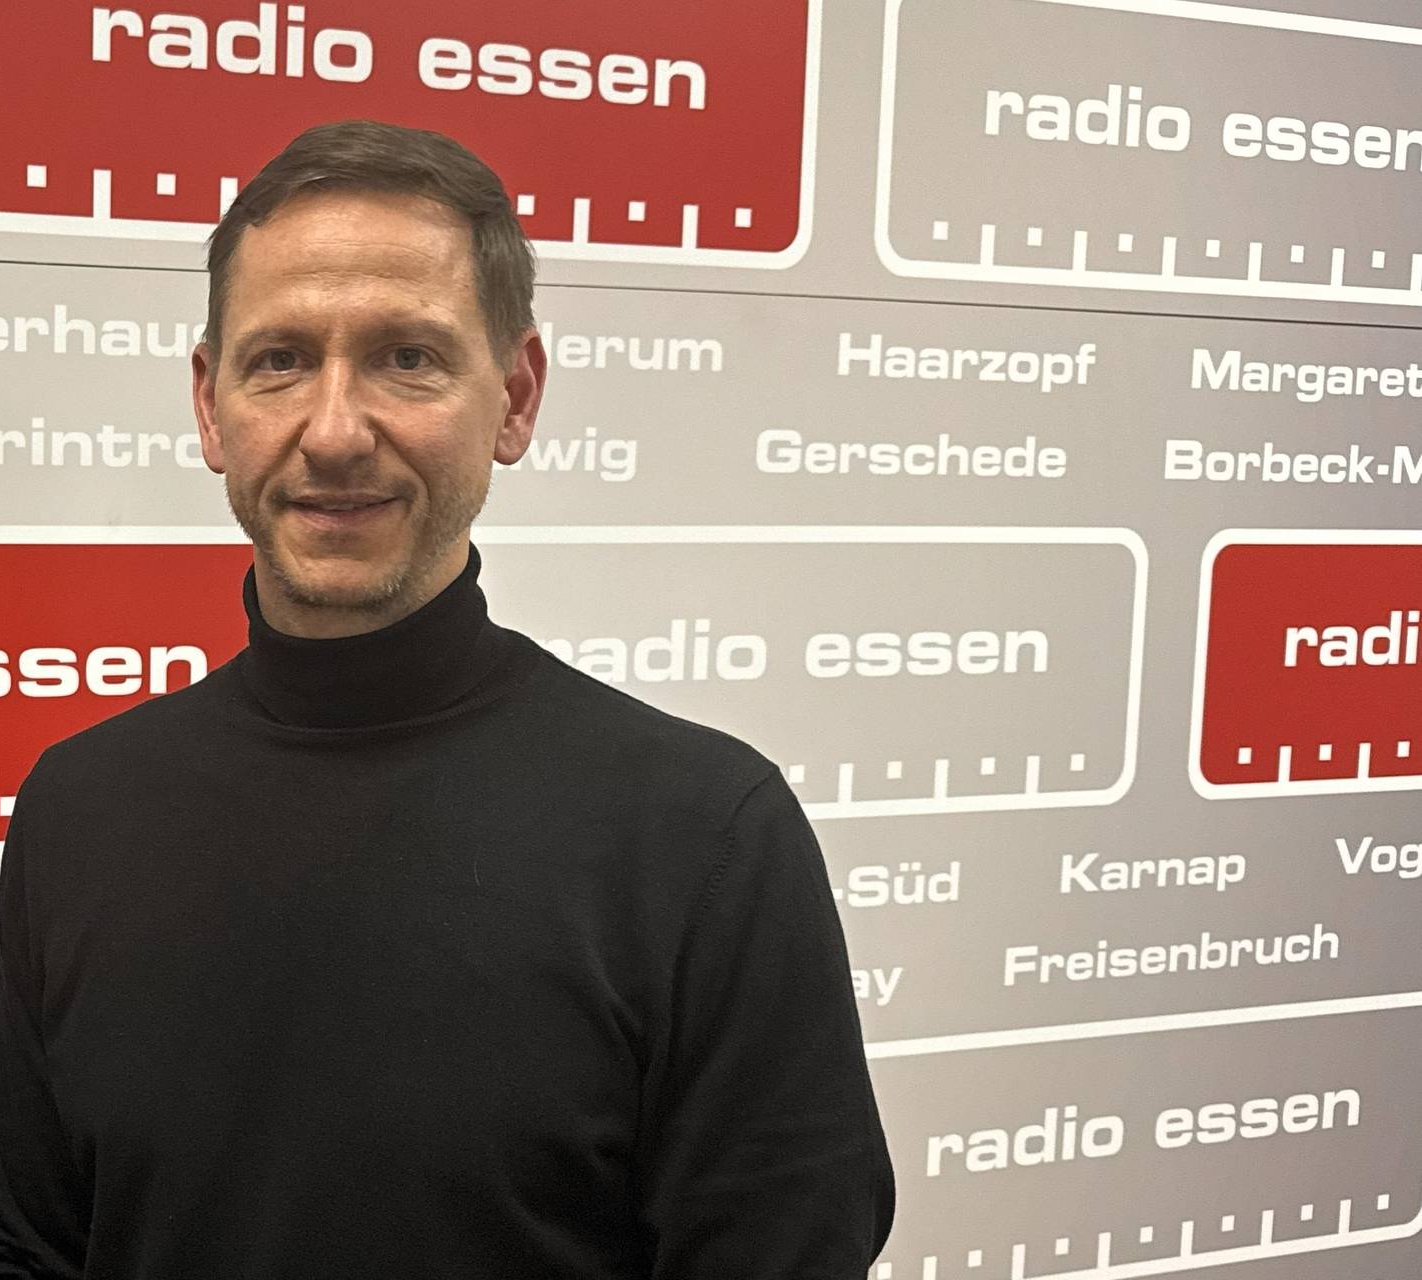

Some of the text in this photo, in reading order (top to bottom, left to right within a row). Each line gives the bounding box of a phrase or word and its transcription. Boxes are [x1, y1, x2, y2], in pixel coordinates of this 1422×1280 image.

[91, 1, 707, 110] radio essen
[985, 84, 1191, 151] radio
[837, 332, 1097, 393] Haarzopf
[1191, 348, 1422, 402] Margaret
[493, 426, 637, 482] wig
[756, 429, 1067, 478] Gerschede
[804, 629, 1050, 679] essen
[1284, 610, 1421, 668] radi
[1060, 852, 1247, 893] Karnap
[1003, 923, 1340, 986] Freisenbruch
[926, 1088, 1361, 1177] radio essen
